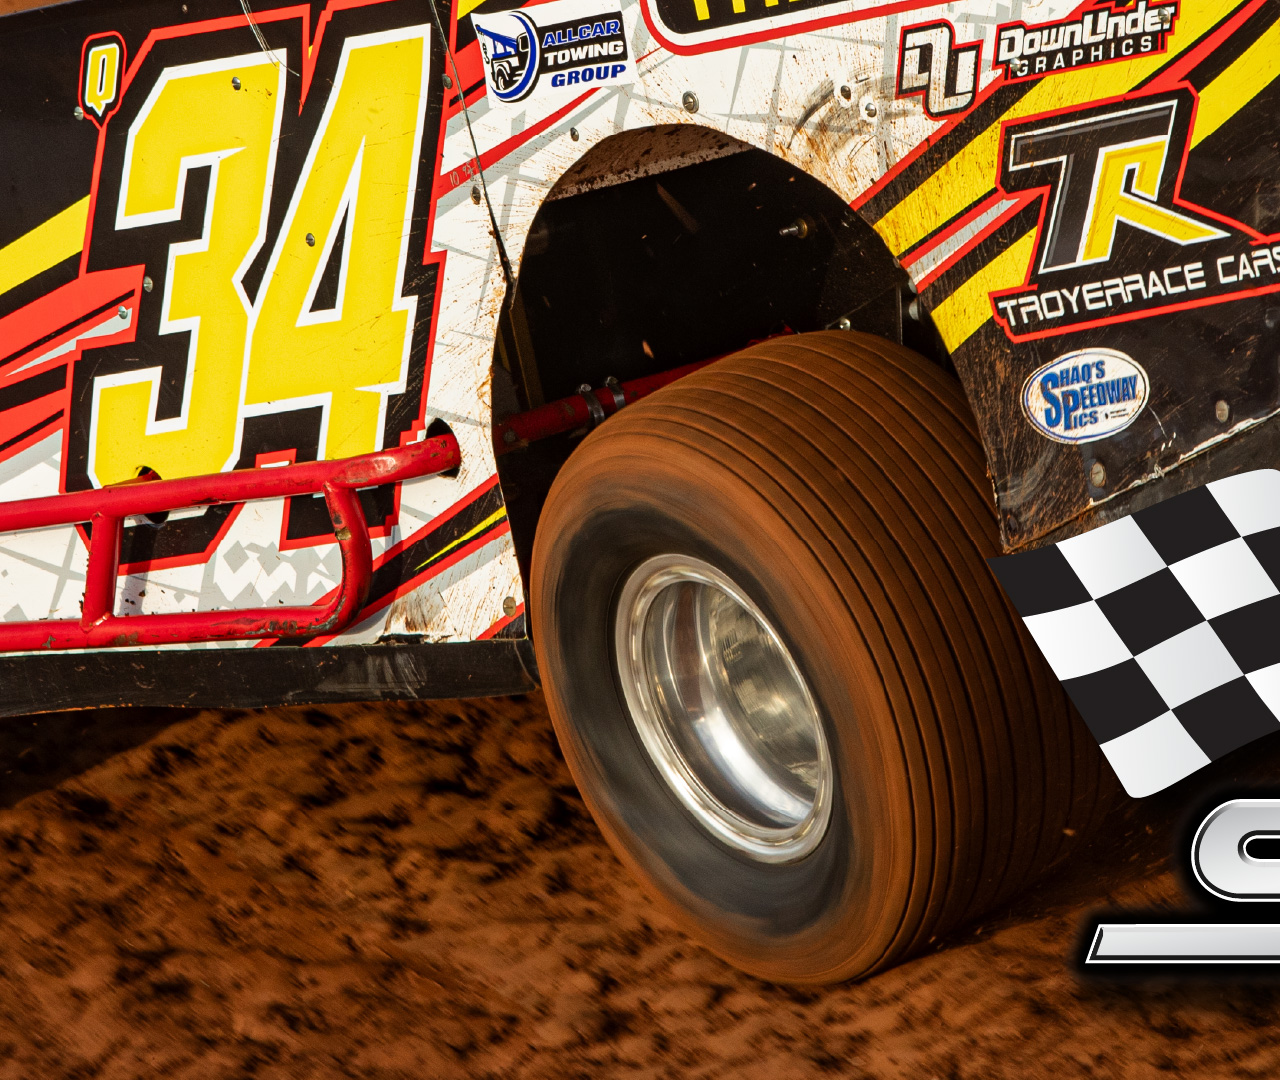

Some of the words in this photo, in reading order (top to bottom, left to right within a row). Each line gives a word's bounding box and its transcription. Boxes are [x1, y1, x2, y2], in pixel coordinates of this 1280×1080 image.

[542, 19, 622, 49] ALLCAR
[544, 40, 624, 67] TOWING
[1016, 35, 1153, 77] GRAPHICS
[87, 42, 120, 118] Q
[551, 63, 627, 88] GROUP
[87, 23, 433, 505] 34
